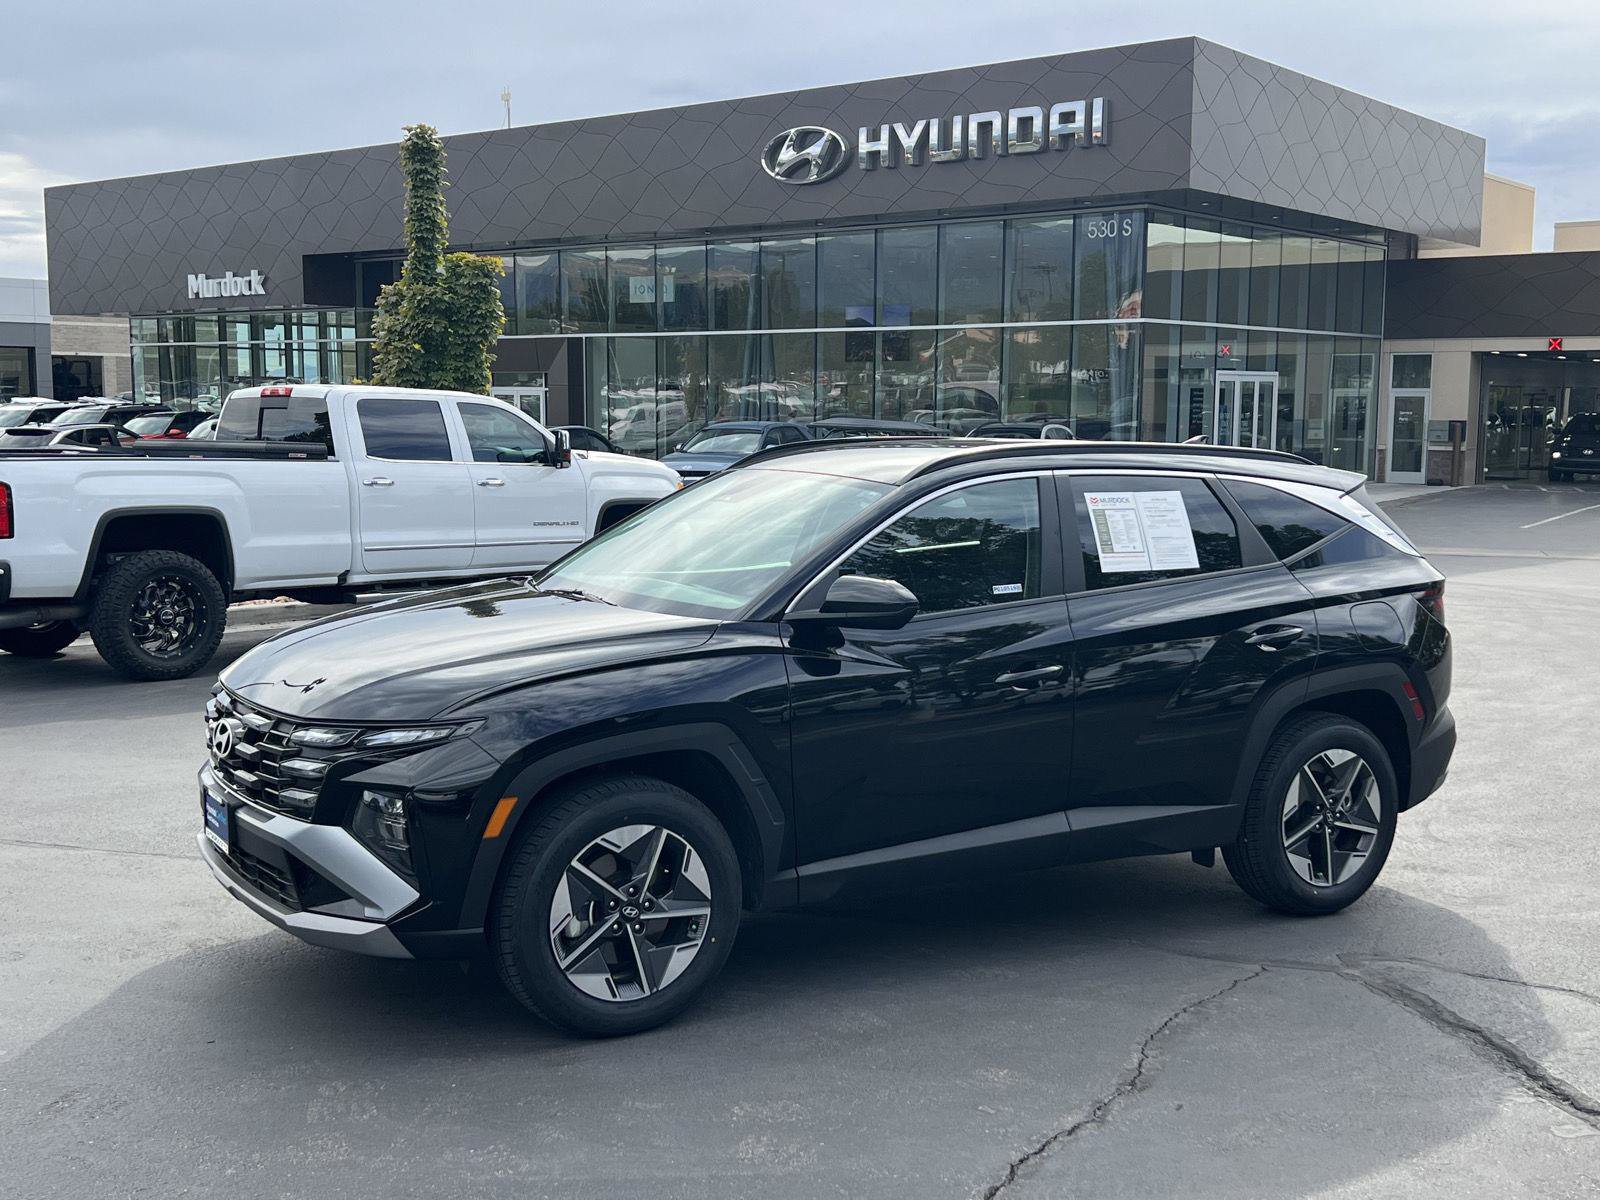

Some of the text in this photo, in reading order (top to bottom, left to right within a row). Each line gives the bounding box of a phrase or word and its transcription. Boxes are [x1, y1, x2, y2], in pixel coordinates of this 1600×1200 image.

[858, 97, 1106, 170] HYUNDAI
[1087, 218, 1132, 238] 530 S
[187, 269, 266, 299] Murdock
